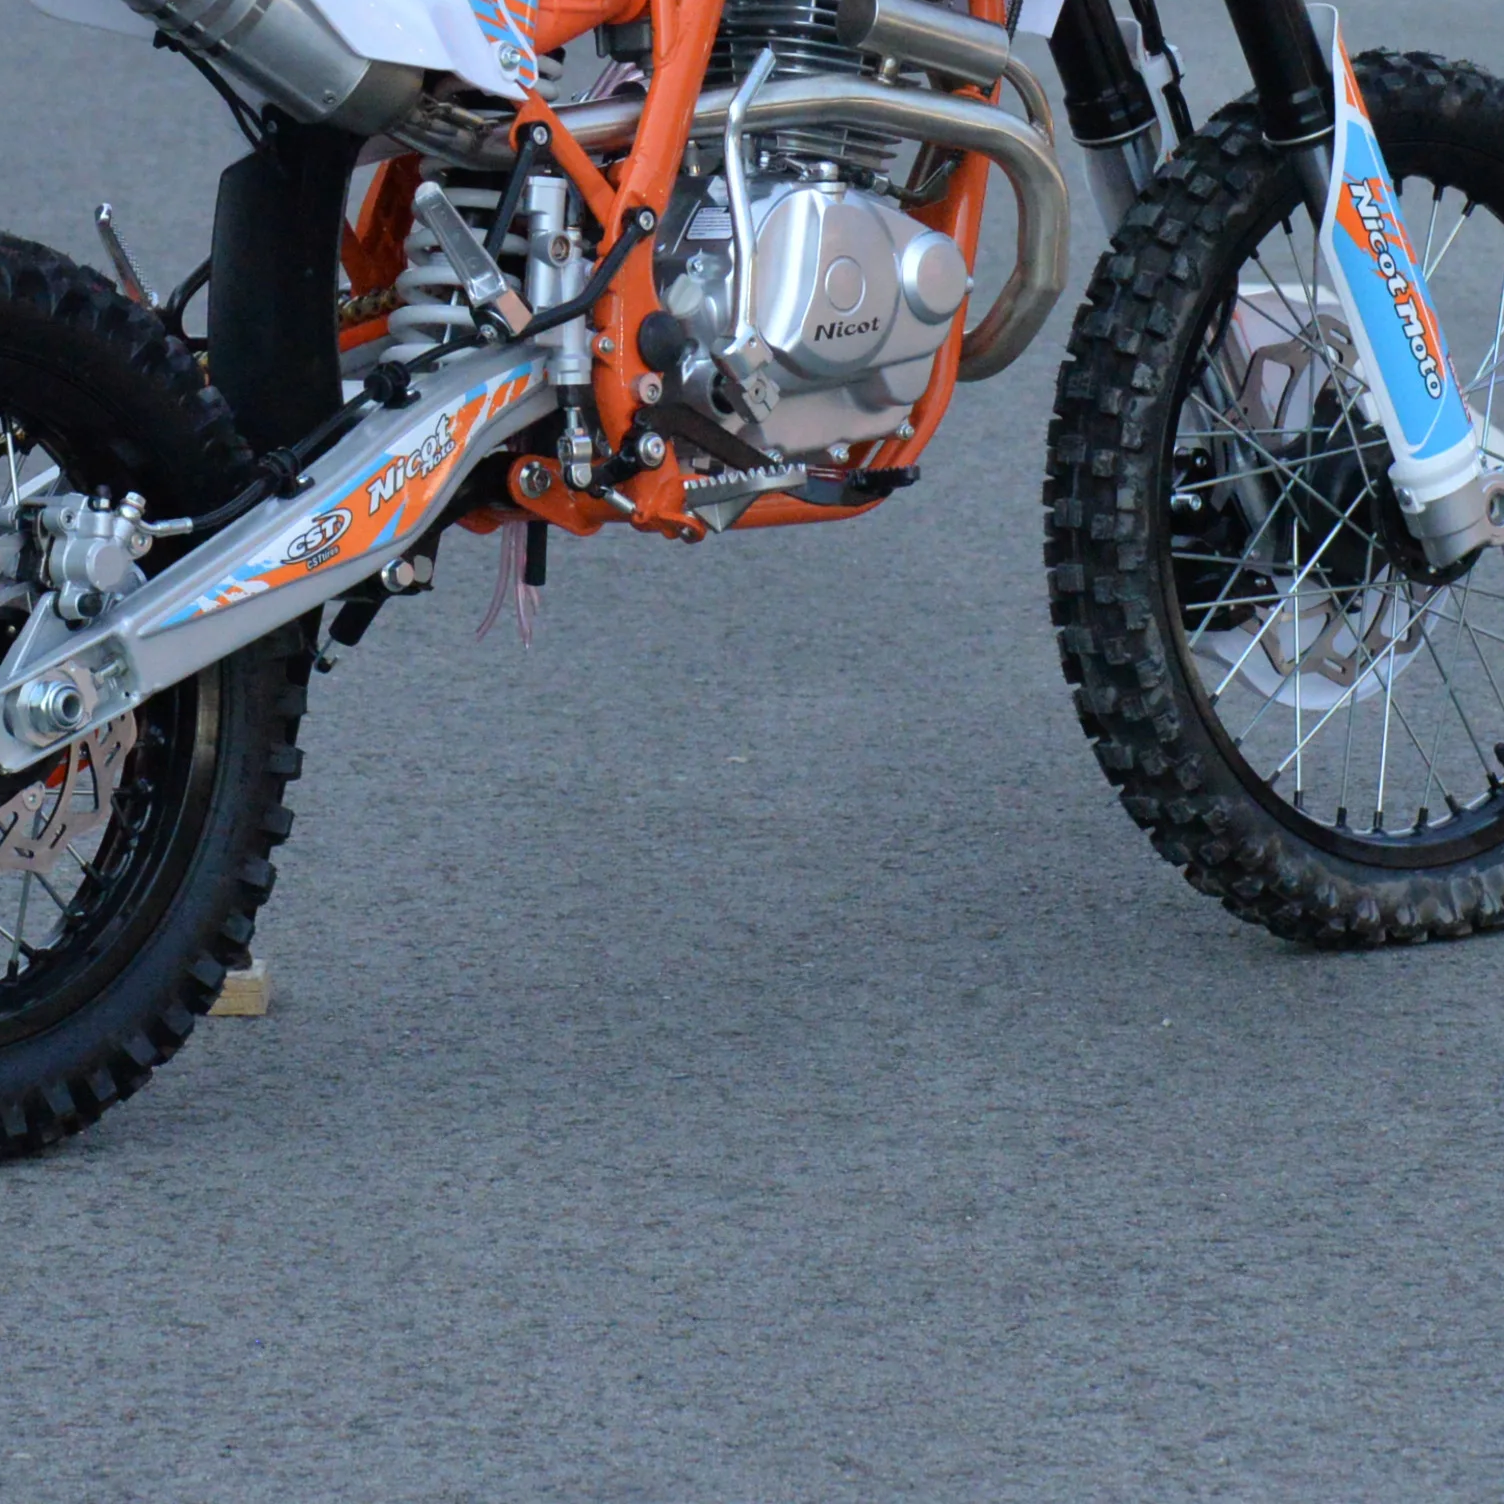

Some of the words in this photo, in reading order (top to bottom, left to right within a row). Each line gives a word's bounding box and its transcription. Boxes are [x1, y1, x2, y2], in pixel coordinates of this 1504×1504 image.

[1348, 177, 1408, 297] Nicot
[1395, 294, 1442, 399] Moto
[814, 316, 880, 342] Nicot
[366, 413, 452, 517] Nicot
[421, 439, 456, 479] Moto
[288, 514, 339, 560] CST
